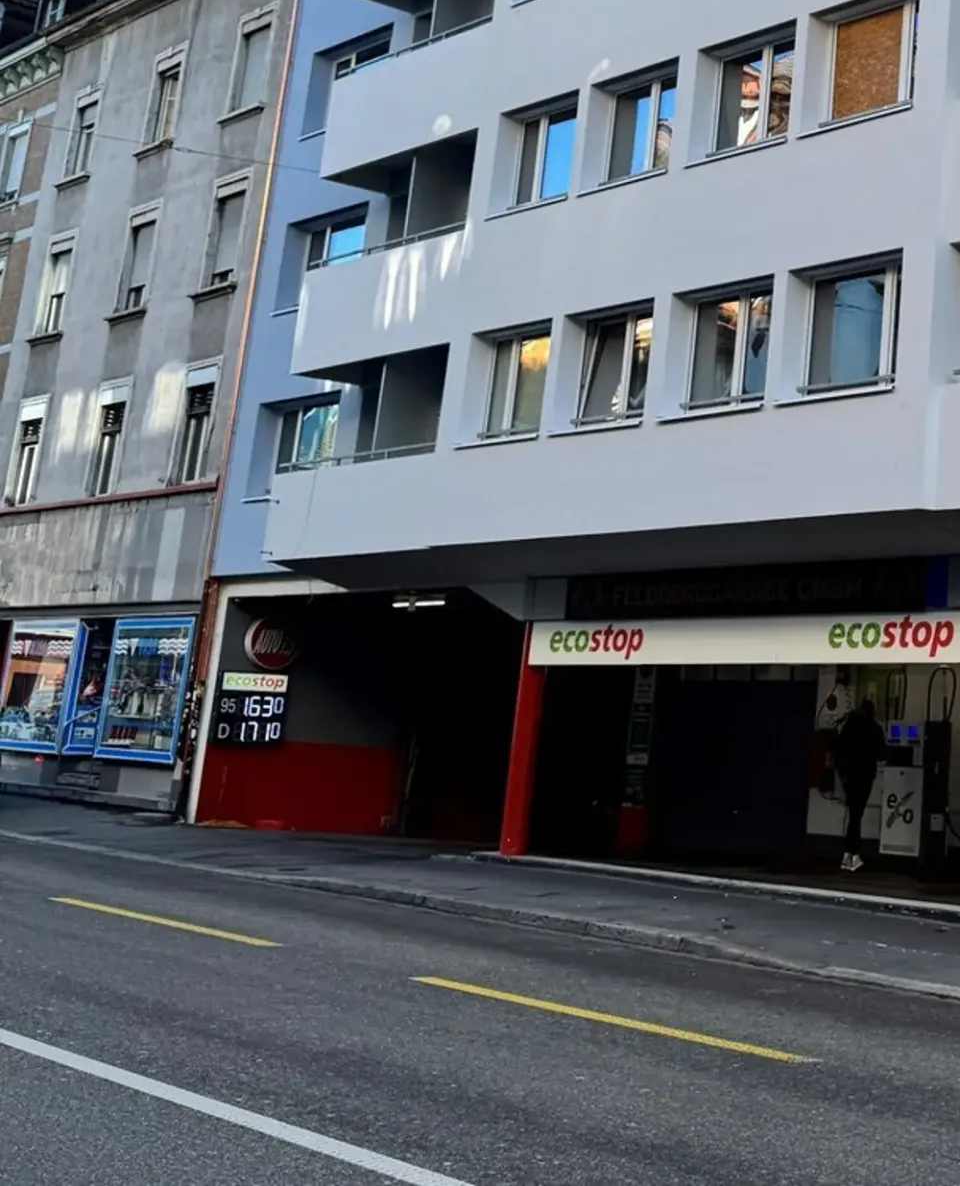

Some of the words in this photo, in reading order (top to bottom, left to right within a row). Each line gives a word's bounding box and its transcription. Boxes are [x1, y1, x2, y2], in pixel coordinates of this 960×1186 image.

[549, 624, 644, 659] ecostop
[828, 615, 954, 657] ecostop
[226, 675, 285, 690] ecostop
[220, 698, 237, 714] 95
[217, 723, 230, 739] D
